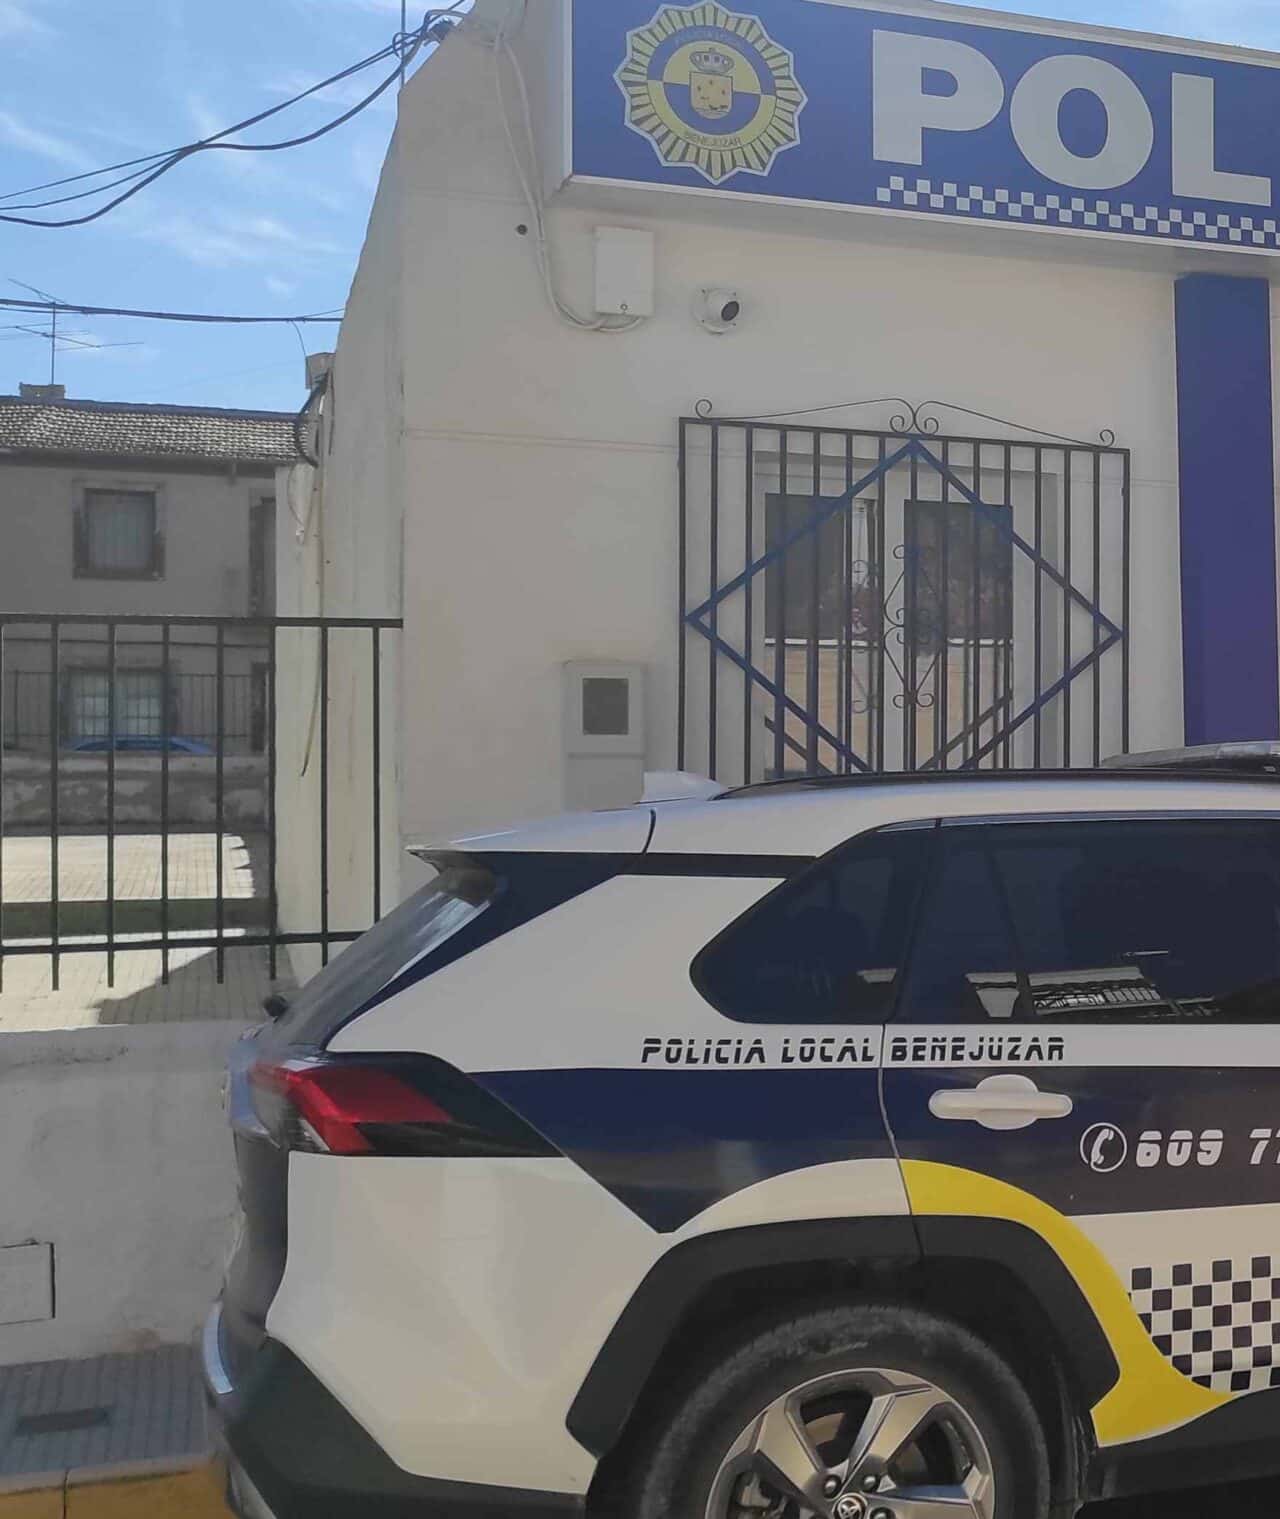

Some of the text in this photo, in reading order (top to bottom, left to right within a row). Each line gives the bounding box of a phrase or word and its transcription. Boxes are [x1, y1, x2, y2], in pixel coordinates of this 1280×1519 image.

[641, 1036, 1065, 1064] POLICIA LOCAL BENEJUZAR
[1135, 1129, 1224, 1168] 609
